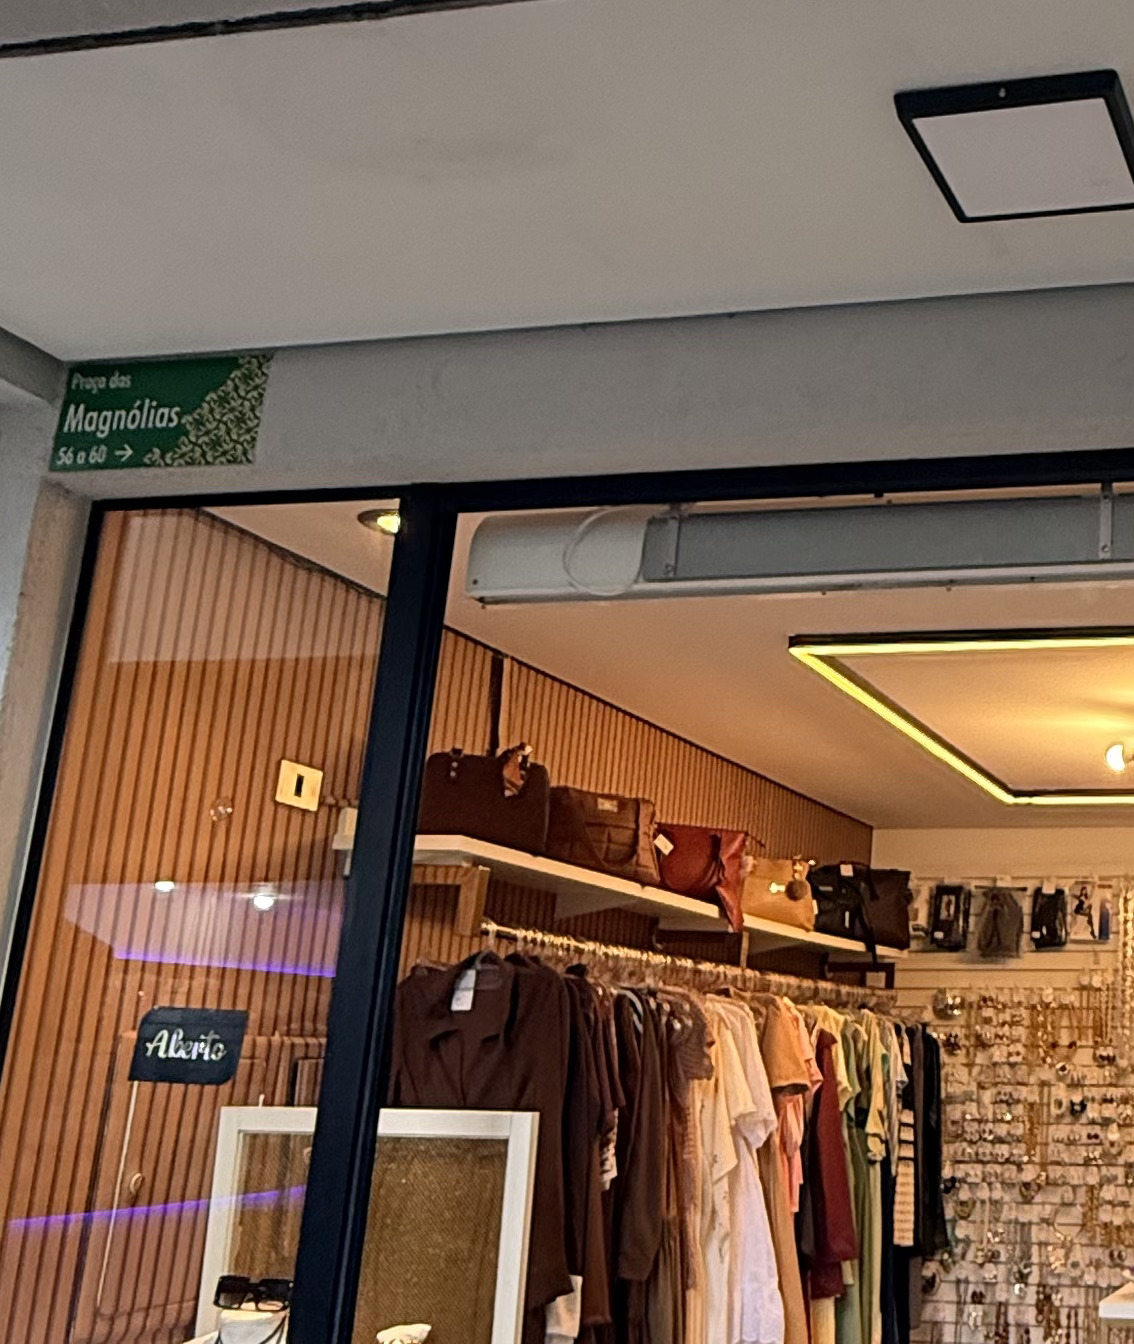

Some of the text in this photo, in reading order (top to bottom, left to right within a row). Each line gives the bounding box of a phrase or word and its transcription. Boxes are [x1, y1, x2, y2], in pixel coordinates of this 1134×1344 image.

[71, 370, 132, 394] Praça das
[63, 398, 181, 438] Magnólias
[56, 444, 108, 465] 56 a 60
[145, 1028, 227, 1061] Aberto
